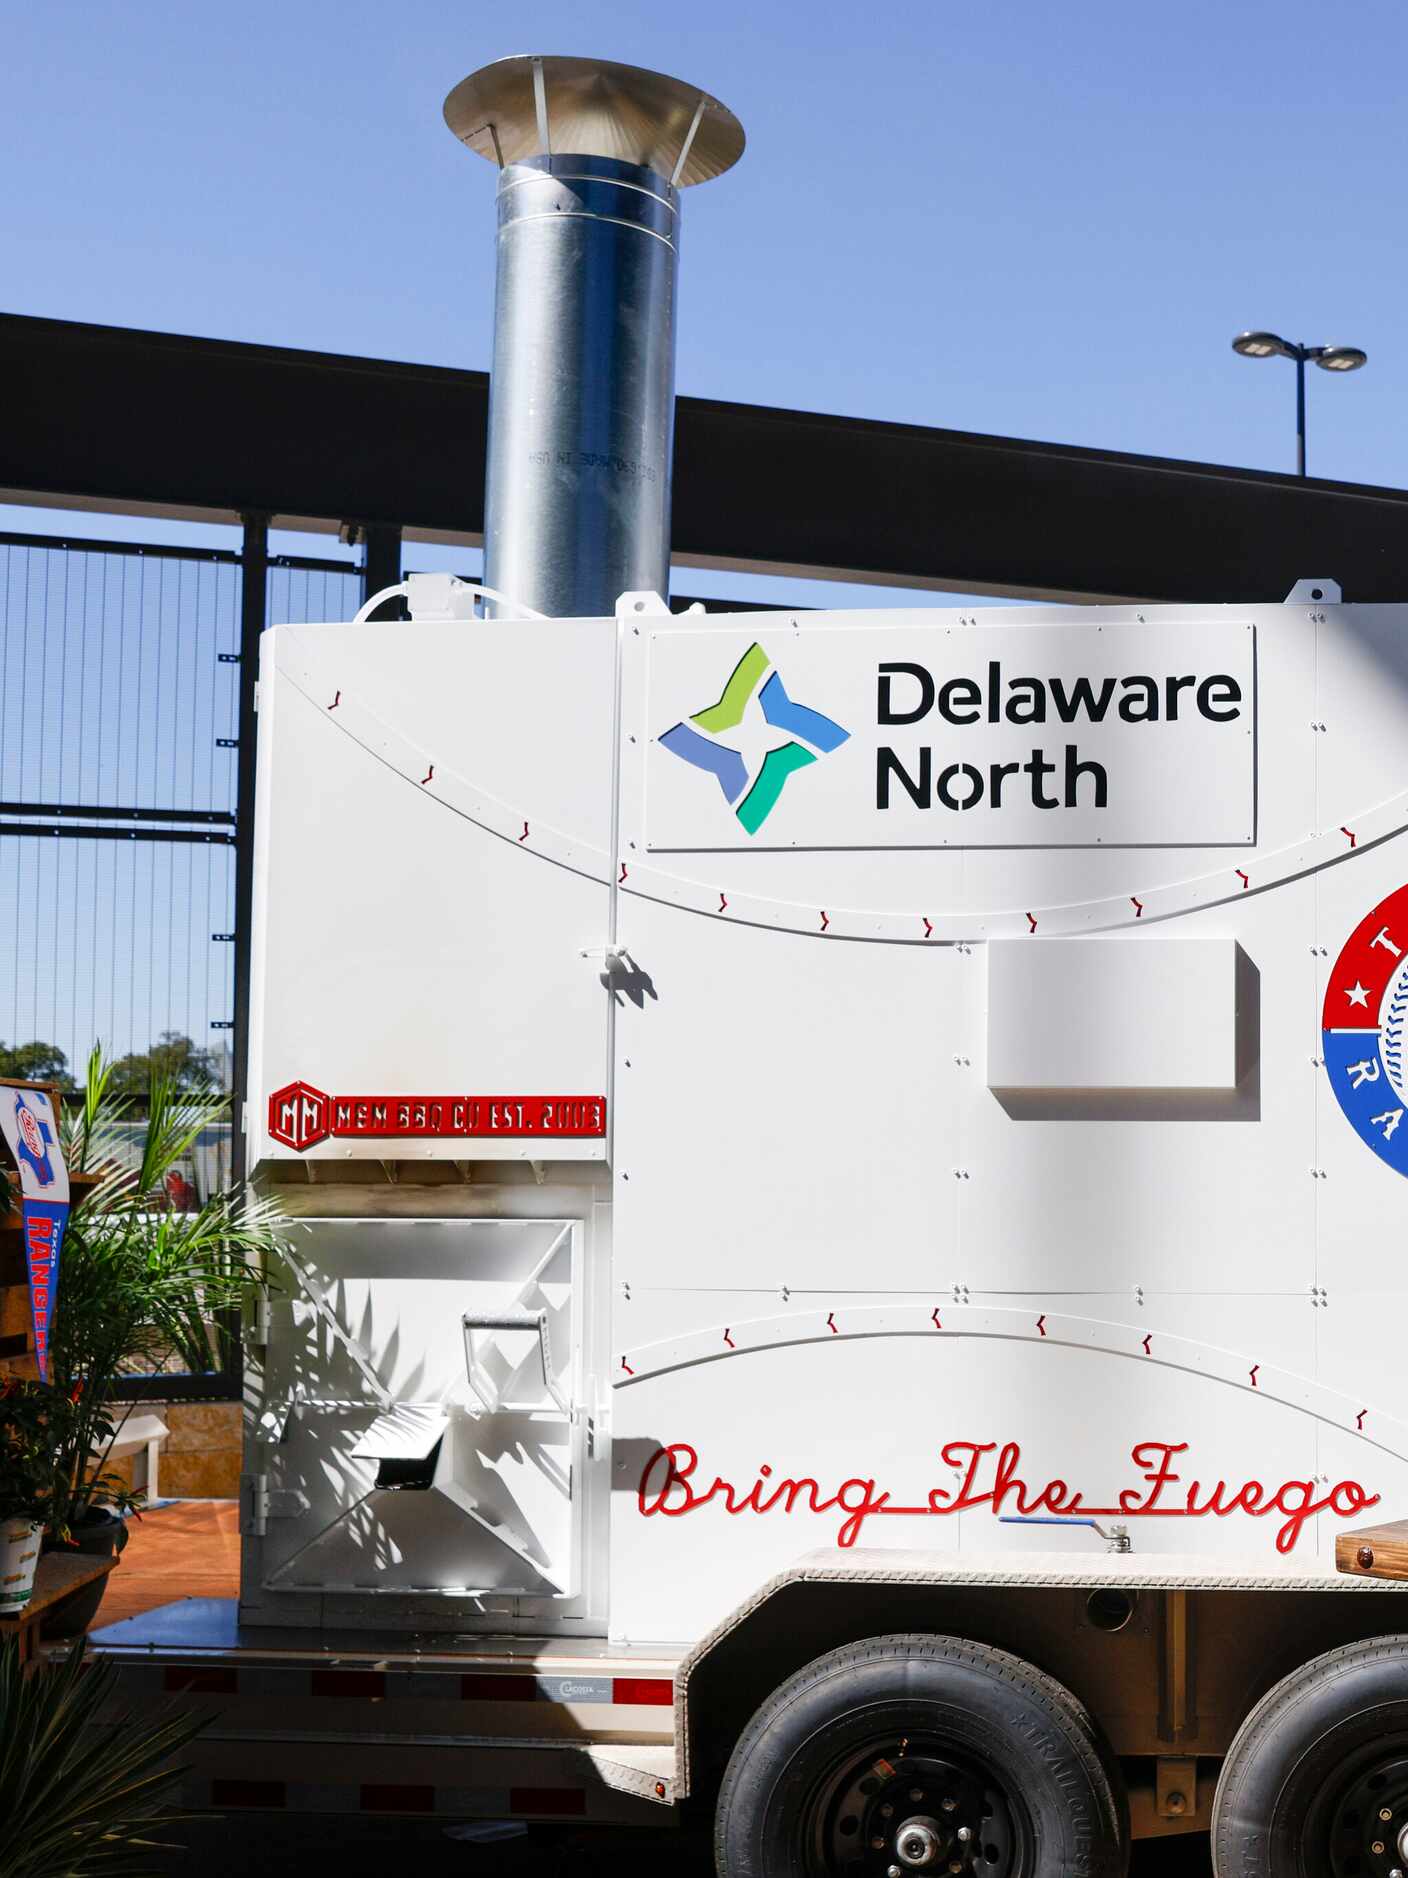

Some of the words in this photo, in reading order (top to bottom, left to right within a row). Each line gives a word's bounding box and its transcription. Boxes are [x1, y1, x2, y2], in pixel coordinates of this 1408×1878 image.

[877, 661, 1242, 725] Delaware
[876, 745, 1108, 811] North
[50, 1218, 61, 1267] Texas
[638, 1443, 884, 1548] Bring
[927, 1441, 1081, 1515] The
[1118, 1442, 1383, 1554] Fuego
